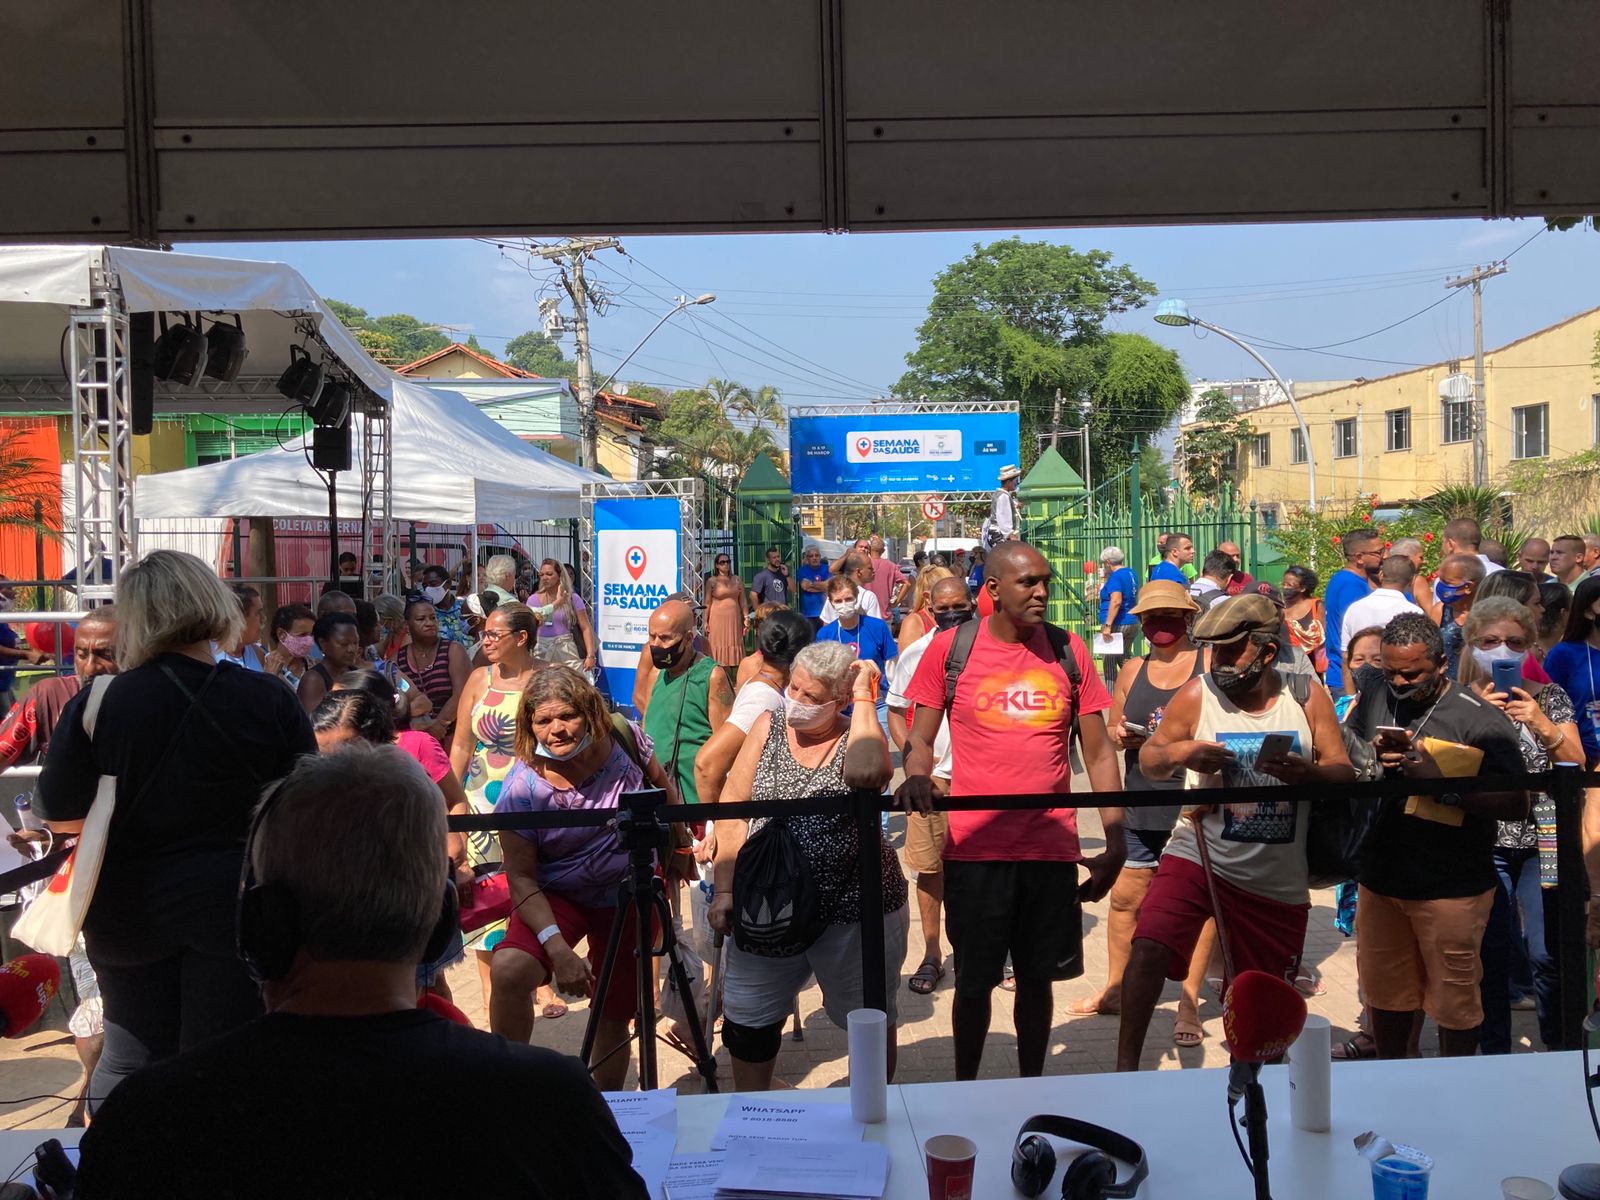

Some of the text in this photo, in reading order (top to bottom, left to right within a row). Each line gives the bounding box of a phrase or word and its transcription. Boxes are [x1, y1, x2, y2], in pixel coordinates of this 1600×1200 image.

[873, 439, 920, 448] SEMANA
[273, 518, 364, 534] COLETA EXERNA
[604, 583, 669, 597] SEMANA
[975, 691, 1059, 712] OAKLEY
[741, 1105, 806, 1114] WHATSAPP
